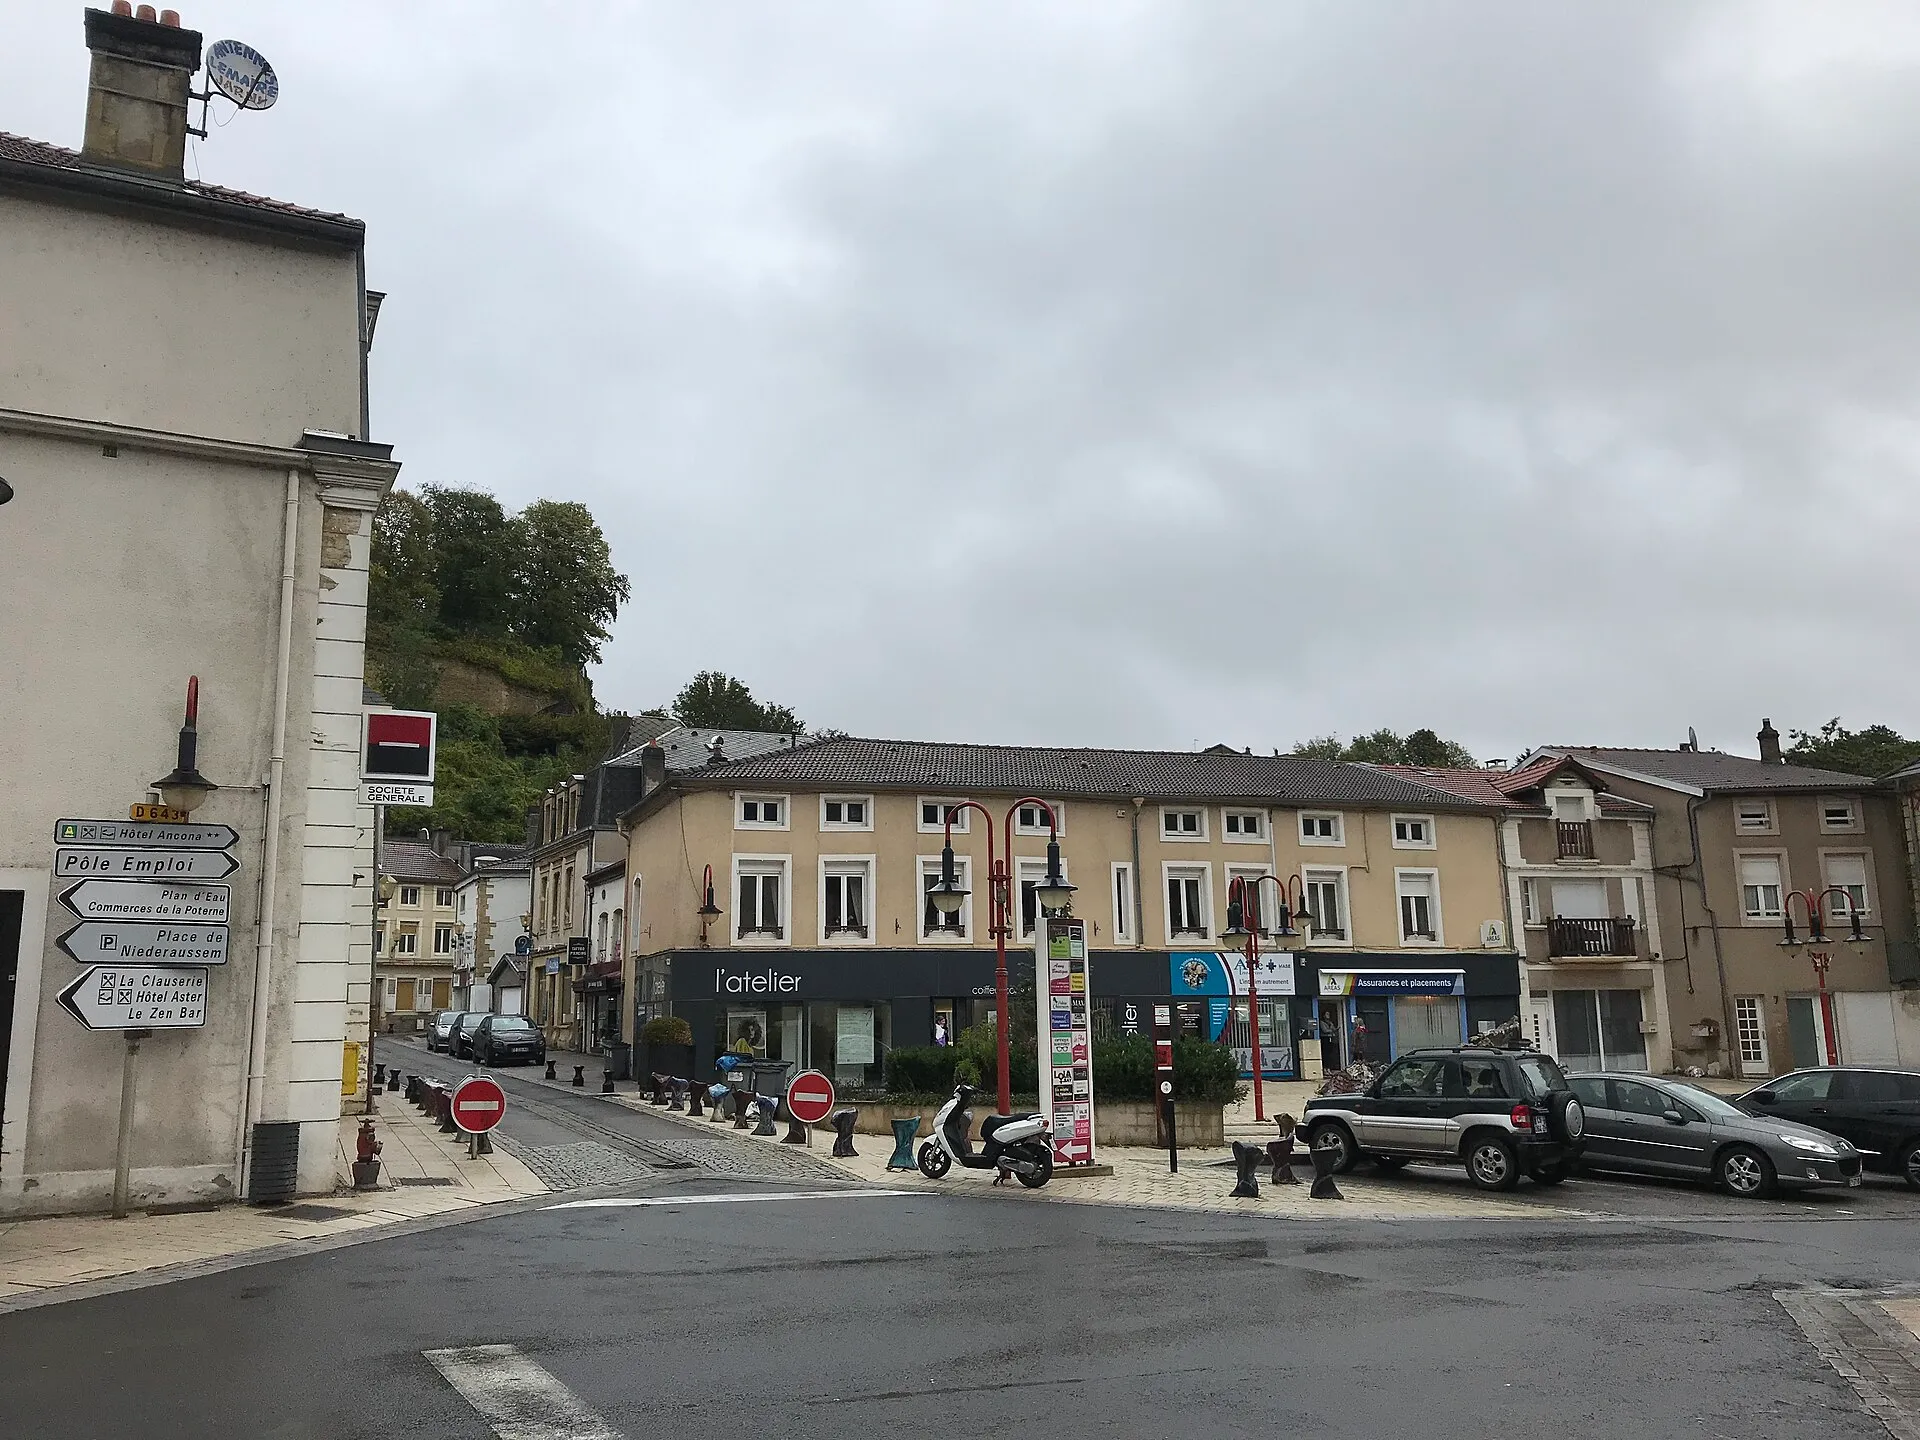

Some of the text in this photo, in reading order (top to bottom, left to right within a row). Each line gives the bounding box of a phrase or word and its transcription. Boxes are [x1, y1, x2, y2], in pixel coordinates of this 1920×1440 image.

[367, 786, 415, 795] SOCIETE
[367, 794, 425, 803] GENERALE
[119, 829, 203, 841] Hôtel Ancona
[64, 855, 194, 875] Pôle Emploi
[161, 890, 226, 902] Plan d'Eau
[88, 901, 225, 916] Commerces de la Poterne
[156, 930, 223, 943] Place de
[120, 945, 222, 958] Niederaussem
[119, 975, 203, 987] La Clauserie
[715, 968, 802, 993] l'atelier
[1357, 978, 1452, 989] Assurances et placements
[136, 991, 203, 1003] Hôtel Aster
[128, 1006, 202, 1019] Le Zen Bar
